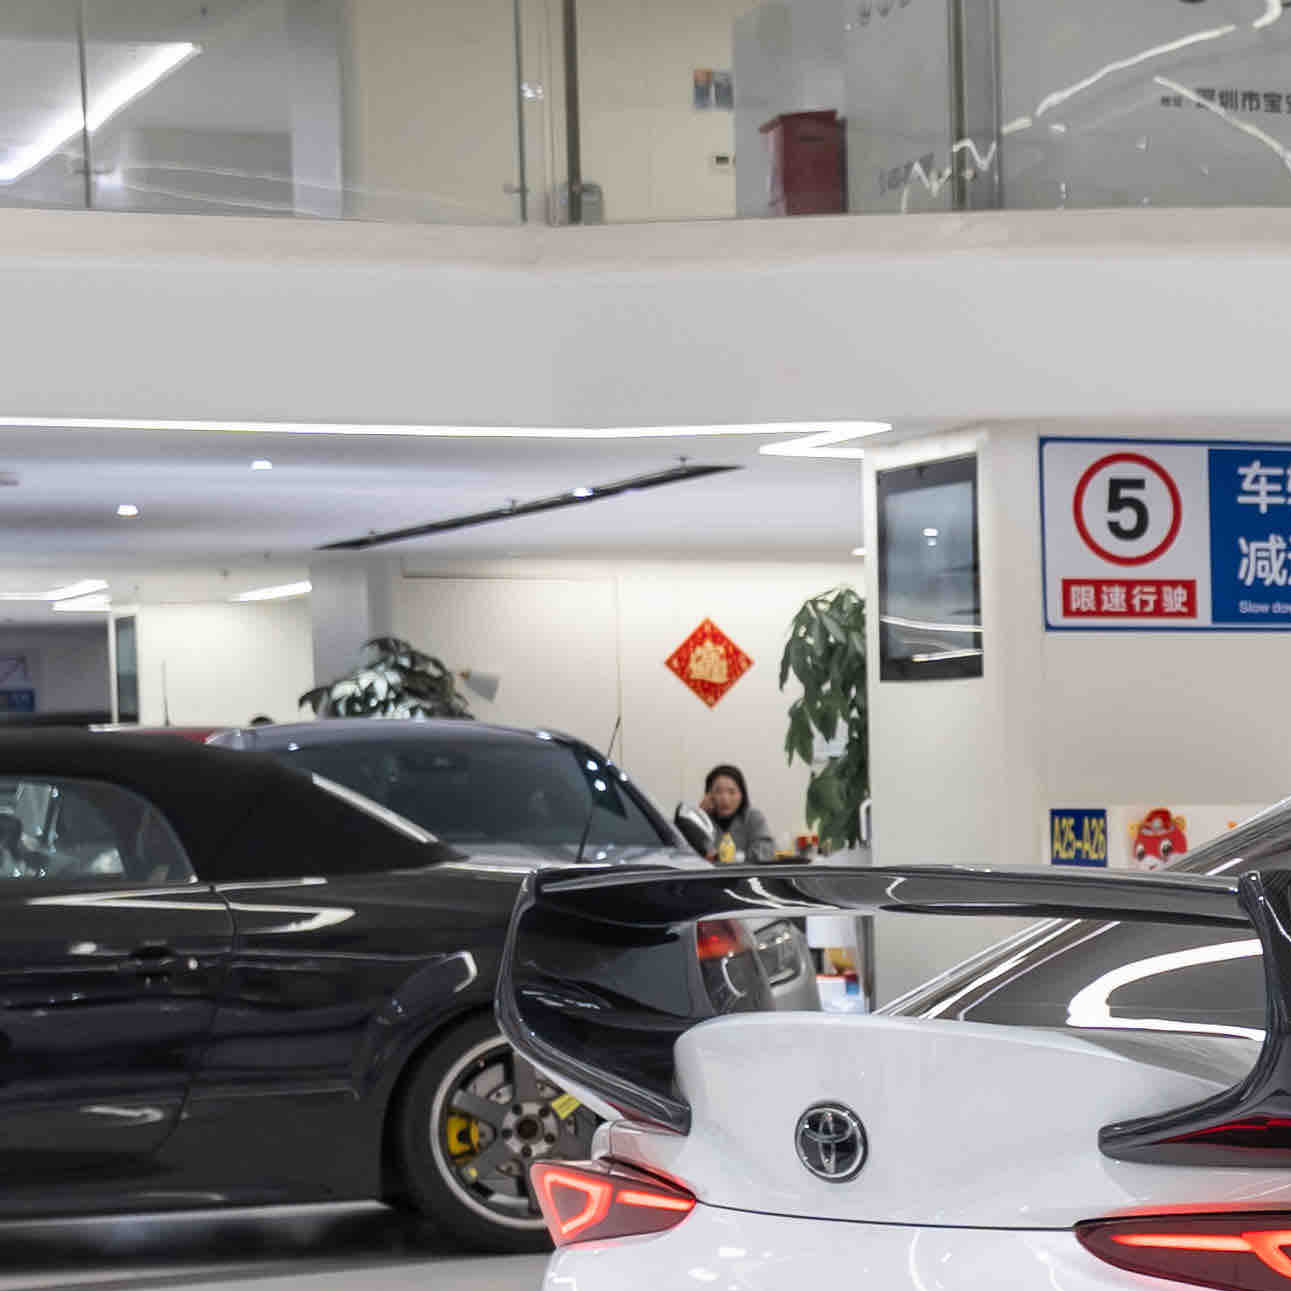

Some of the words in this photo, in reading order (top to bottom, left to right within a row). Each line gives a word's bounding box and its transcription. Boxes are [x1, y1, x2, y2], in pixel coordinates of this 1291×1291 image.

[1107, 478, 1149, 542] 5
[1069, 585, 1189, 613] 限速行驶
[1239, 600, 1269, 615] Slow
